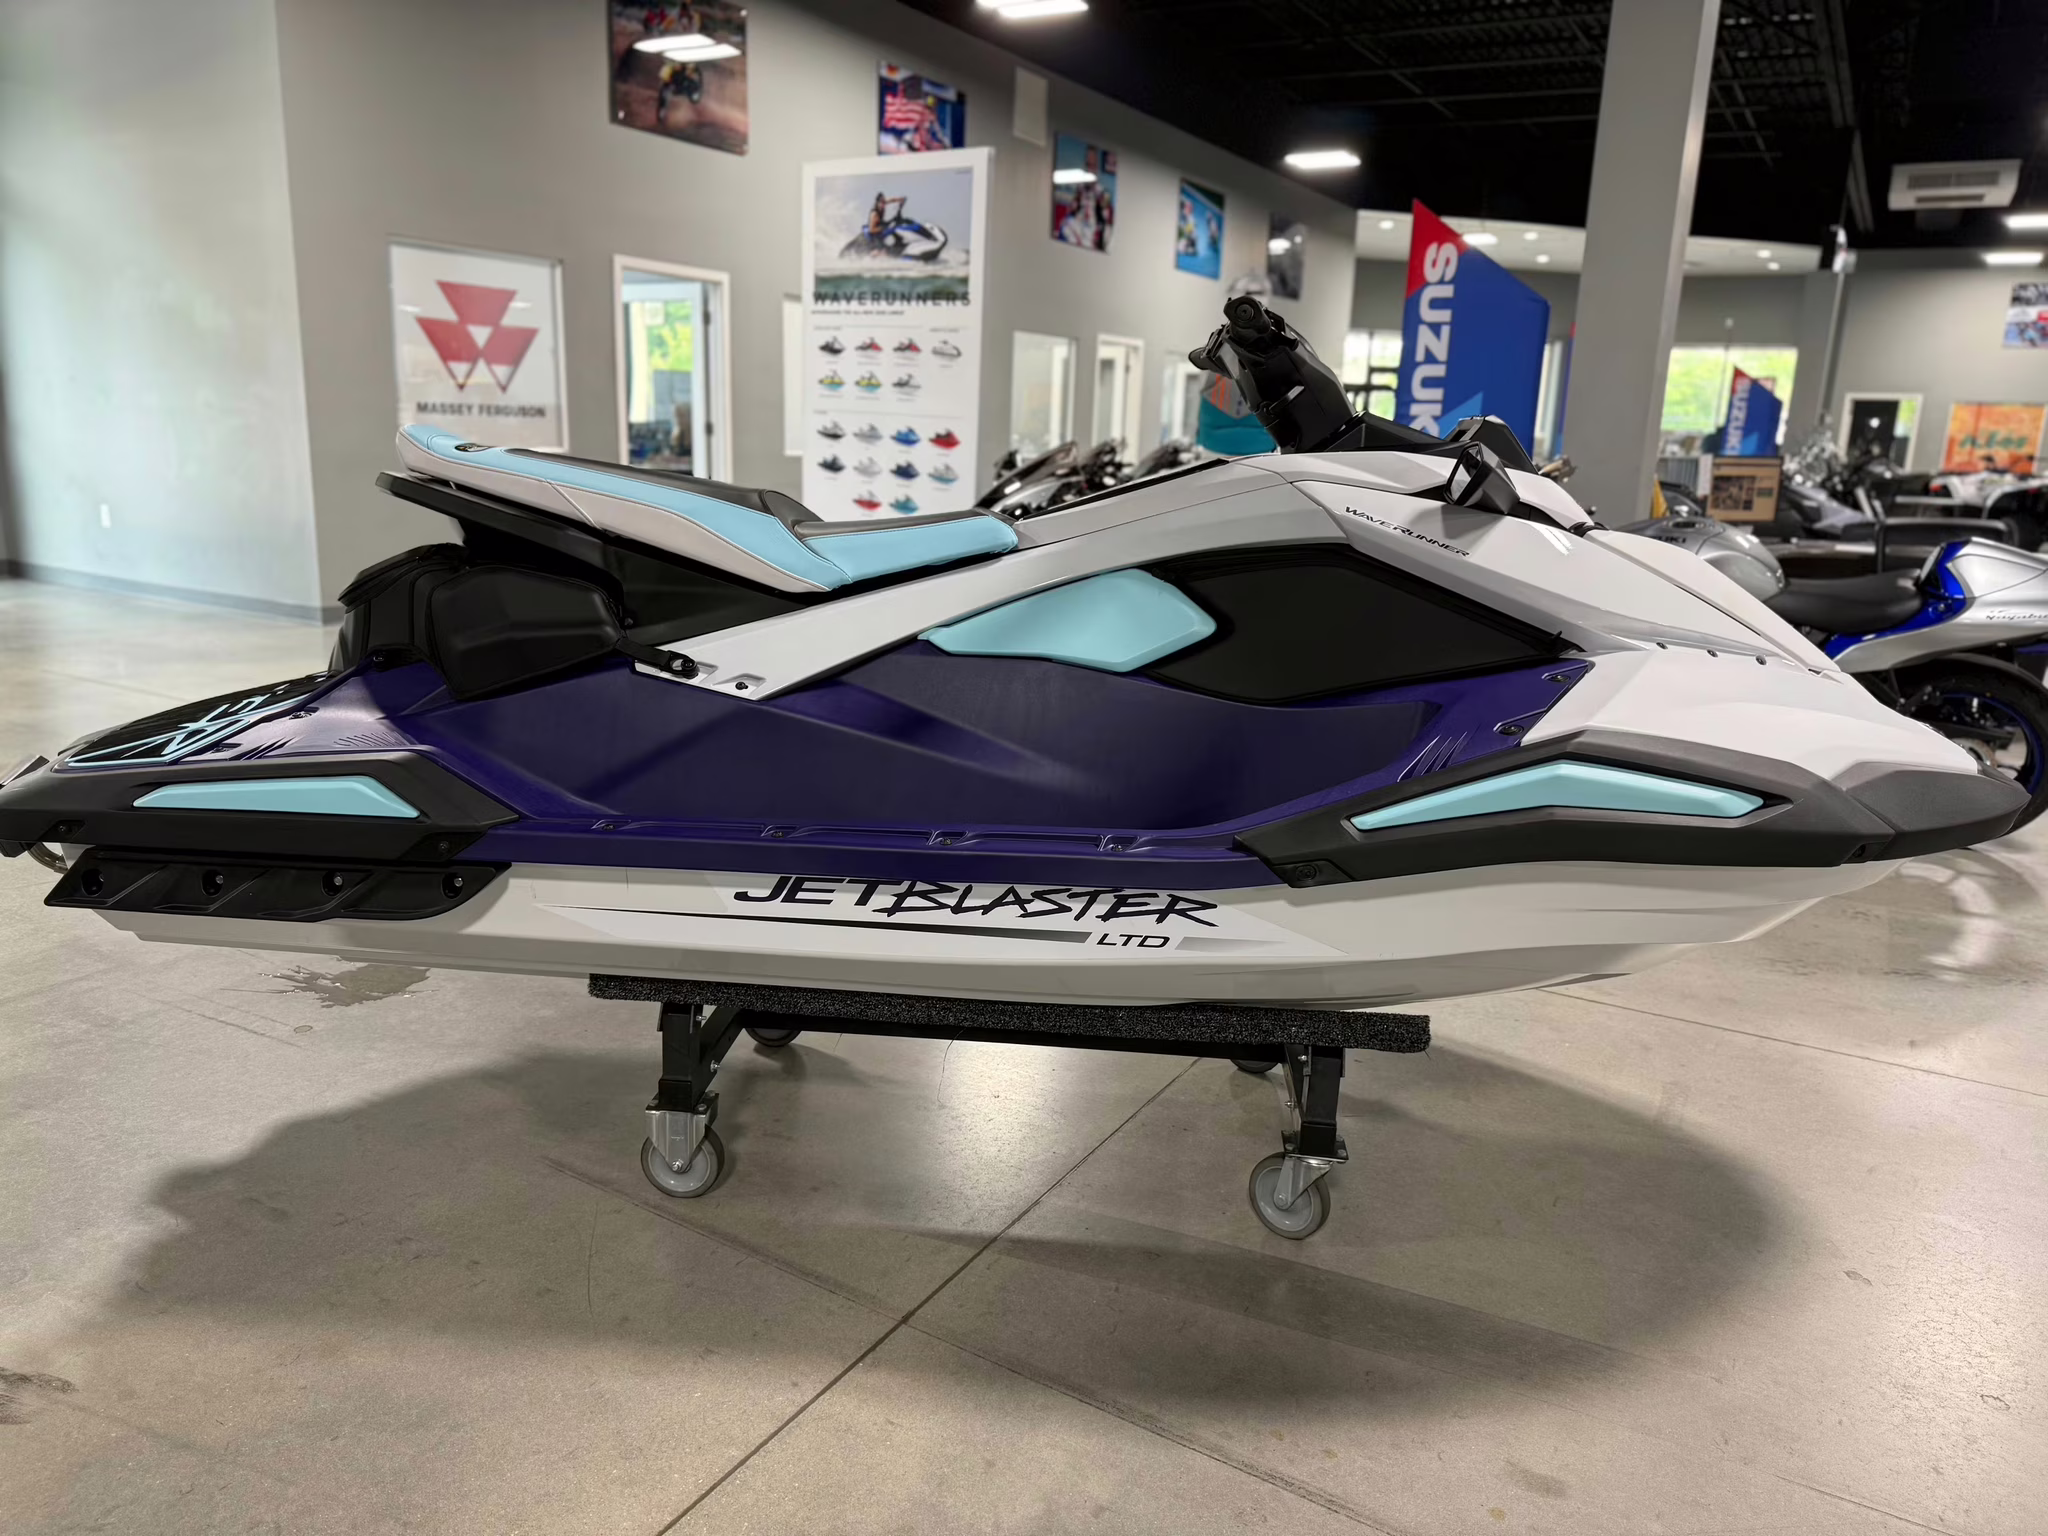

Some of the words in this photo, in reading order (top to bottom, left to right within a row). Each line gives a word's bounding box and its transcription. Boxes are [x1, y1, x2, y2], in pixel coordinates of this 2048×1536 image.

[813, 291, 971, 307] WAVERUNNERS
[1408, 242, 1459, 437] SUZUK
[416, 402, 473, 416] MASSEY
[478, 404, 547, 418] FERGUSON
[1345, 506, 1470, 557] WAVERUNNER
[1096, 932, 1171, 949] LTD
